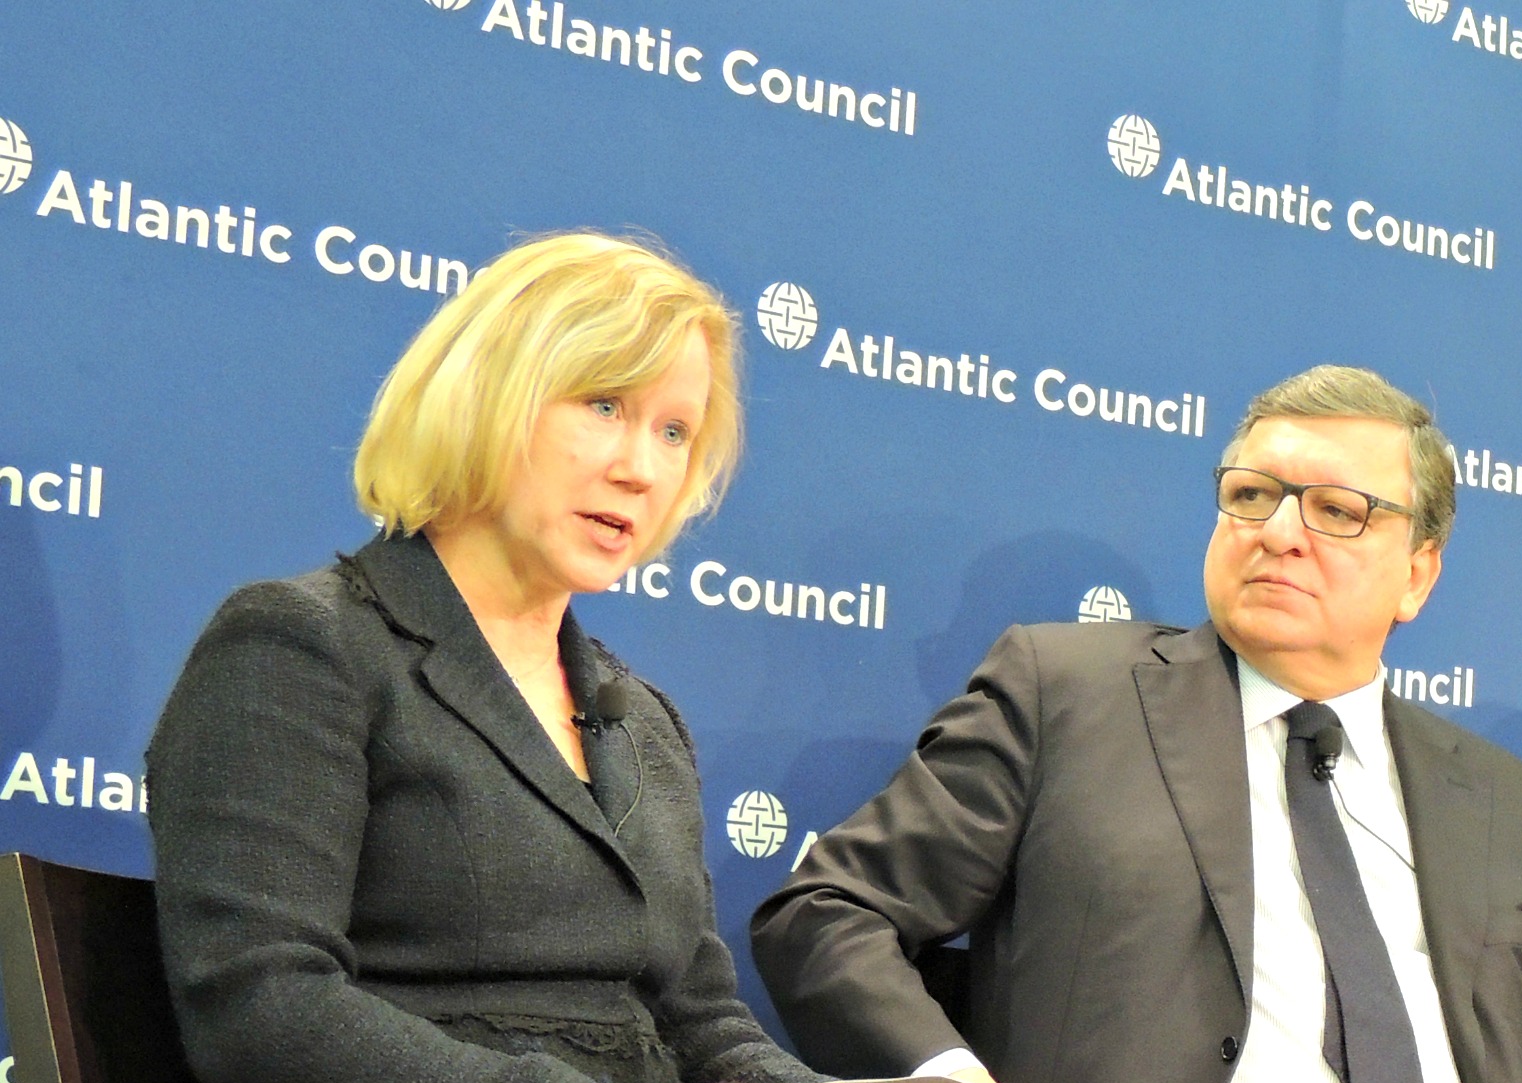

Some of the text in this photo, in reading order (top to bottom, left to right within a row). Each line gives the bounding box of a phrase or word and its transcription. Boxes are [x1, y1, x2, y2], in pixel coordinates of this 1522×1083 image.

[481, 0, 916, 136] Atlantic Council
[37, 170, 490, 297] Atlantic Coun
[1162, 158, 1495, 270] Atlantic Council
[820, 328, 1206, 438] Atlantic Council
[690, 561, 886, 630] Council
